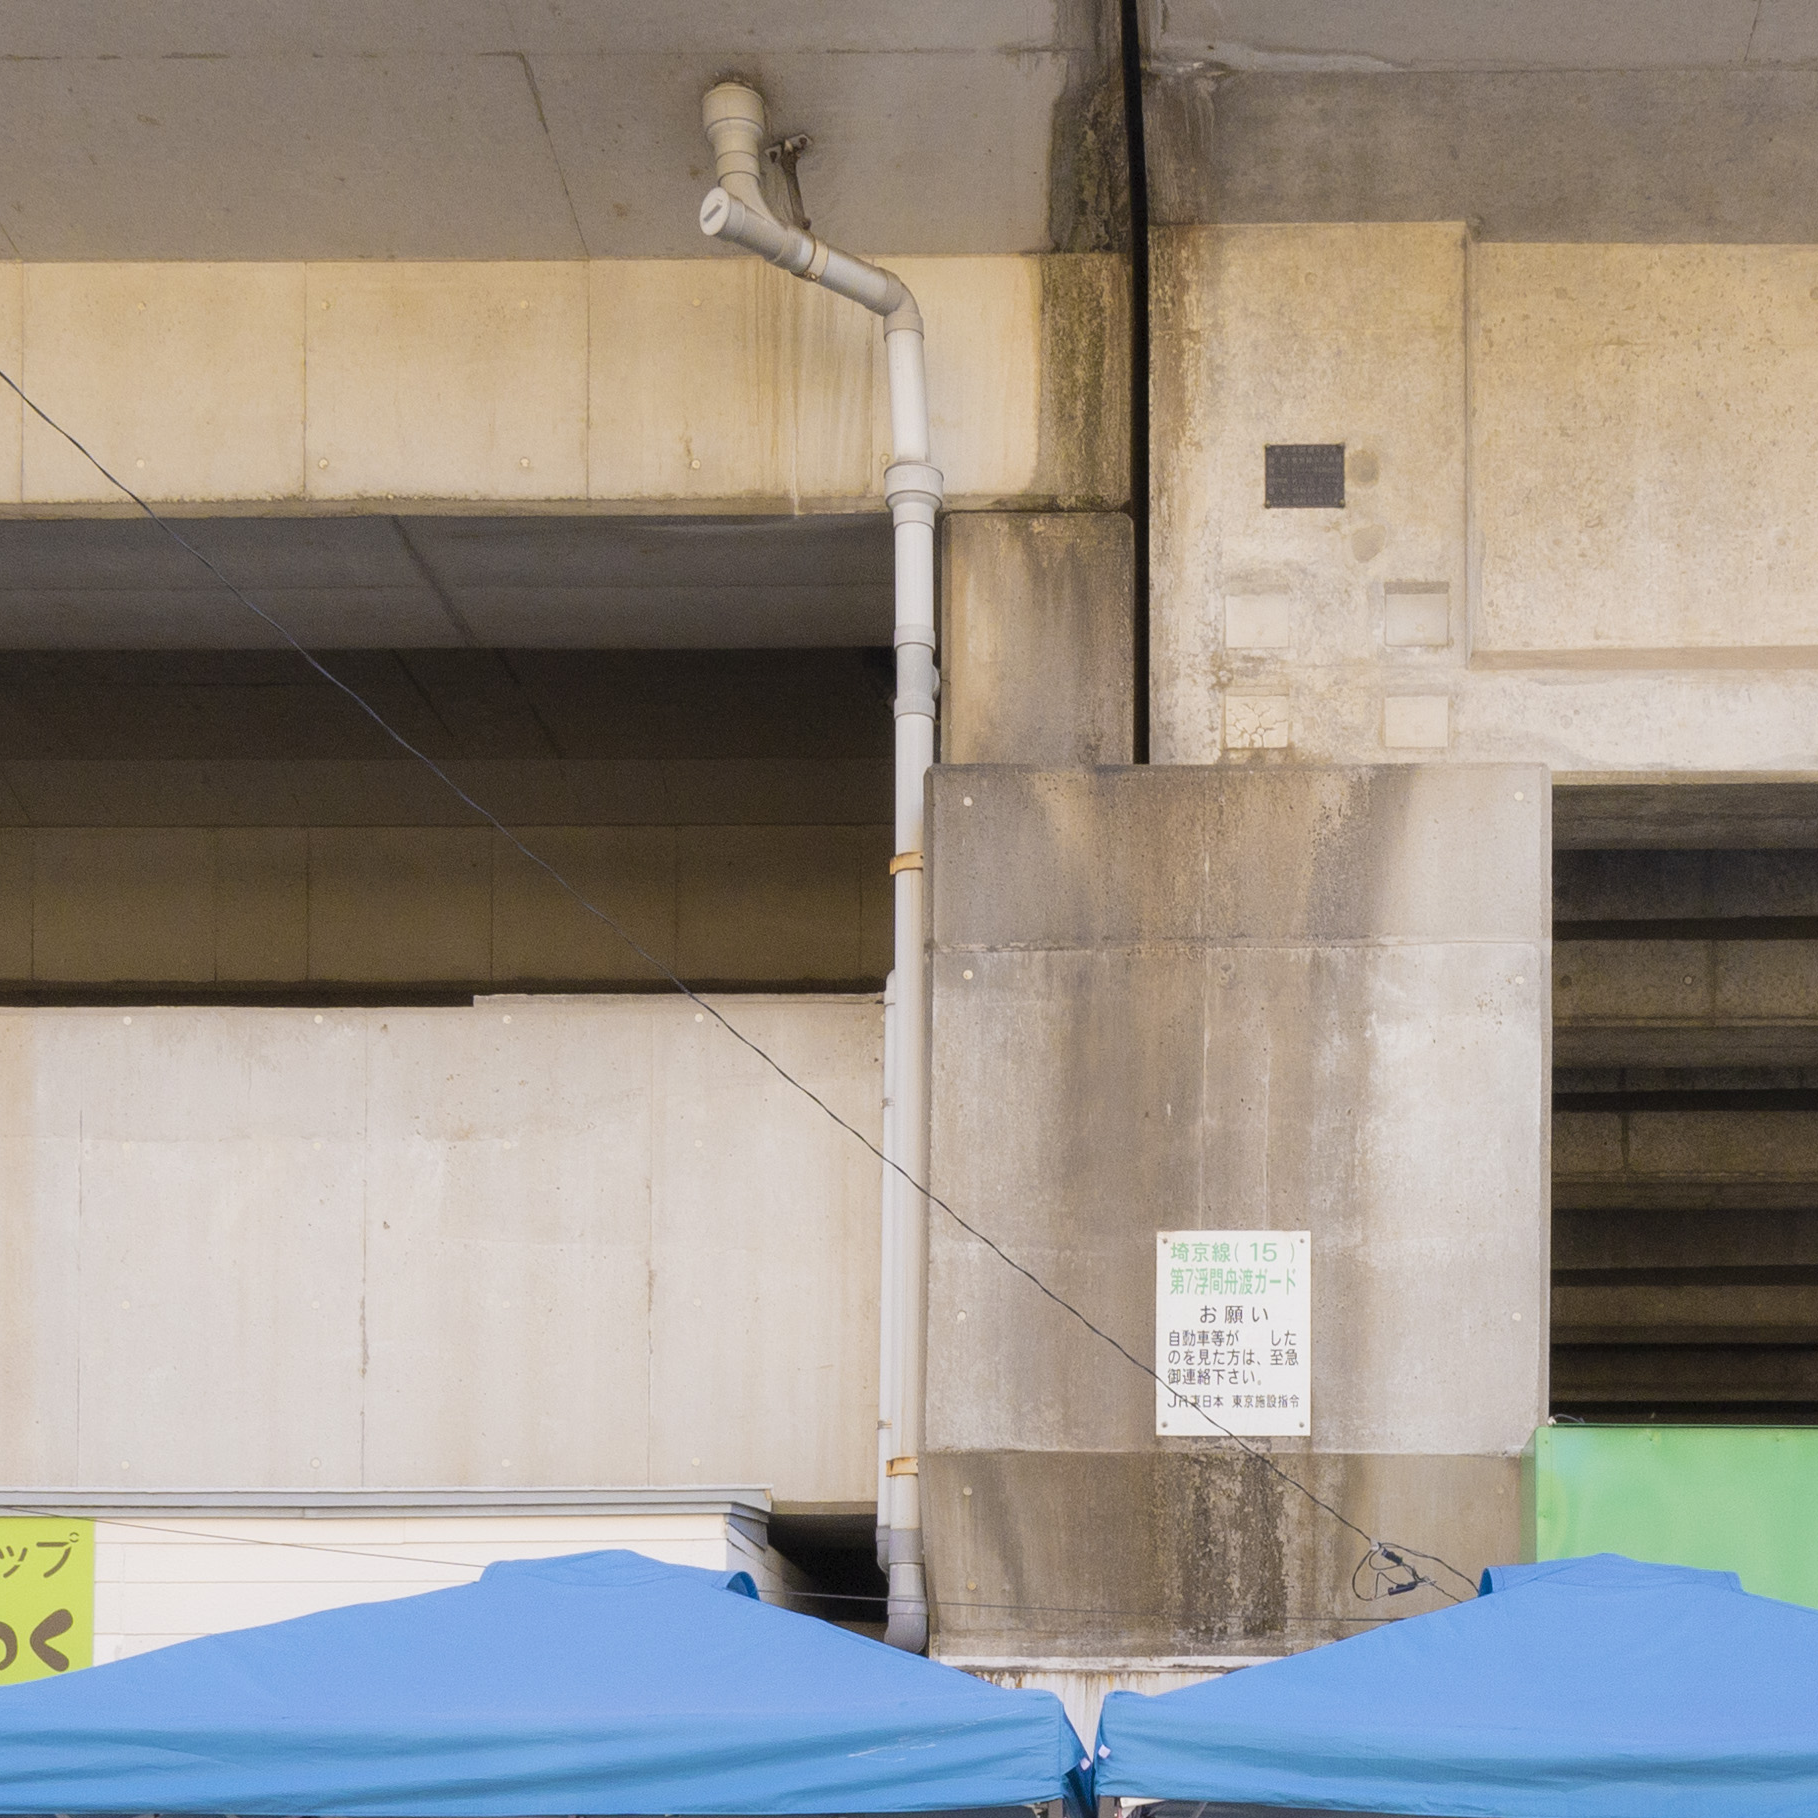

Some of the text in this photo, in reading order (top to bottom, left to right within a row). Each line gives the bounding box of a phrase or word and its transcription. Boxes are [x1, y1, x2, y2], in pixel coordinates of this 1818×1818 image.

[1169, 1268, 1296, 1295] 第7浮間舟渡ガード
[1199, 1305, 1269, 1324] お願い
[1168, 1330, 1297, 1347] 自動車等が した
[1167, 1349, 1299, 1366] のを見た方は、至急
[1167, 1369, 1262, 1386] 御連絡下さい。
[1167, 1395, 1224, 1408] JR東日本
